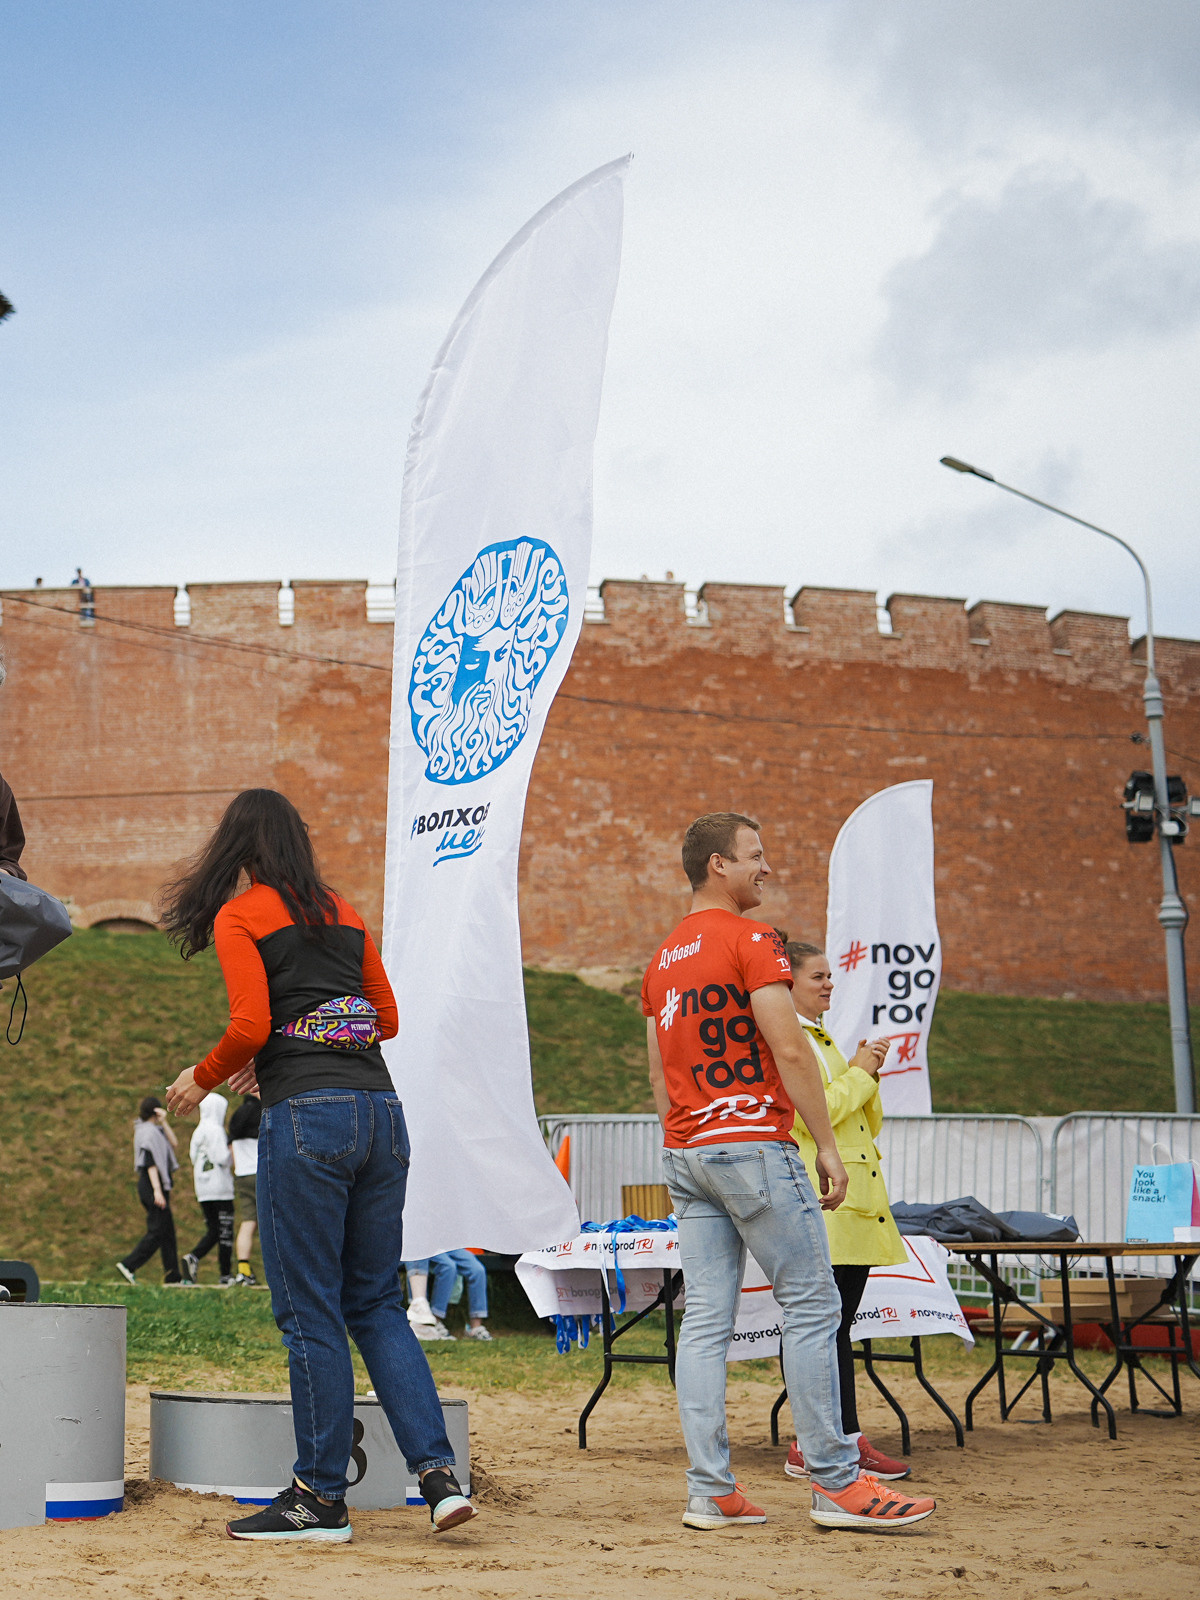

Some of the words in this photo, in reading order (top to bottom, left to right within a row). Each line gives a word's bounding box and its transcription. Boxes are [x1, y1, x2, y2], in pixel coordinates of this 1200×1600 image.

[658, 934, 702, 970] Дубовой
[839, 940, 935, 972] #nov
[888, 969, 935, 1000] go
[660, 984, 751, 1031] #nov
[699, 1015, 757, 1058] go
[690, 1041, 765, 1092] rod
[1135, 1178, 1156, 1187] look
[1136, 1169, 1155, 1178] You
[1132, 1194, 1166, 1203] snack!
[1133, 1185, 1152, 1194] like
